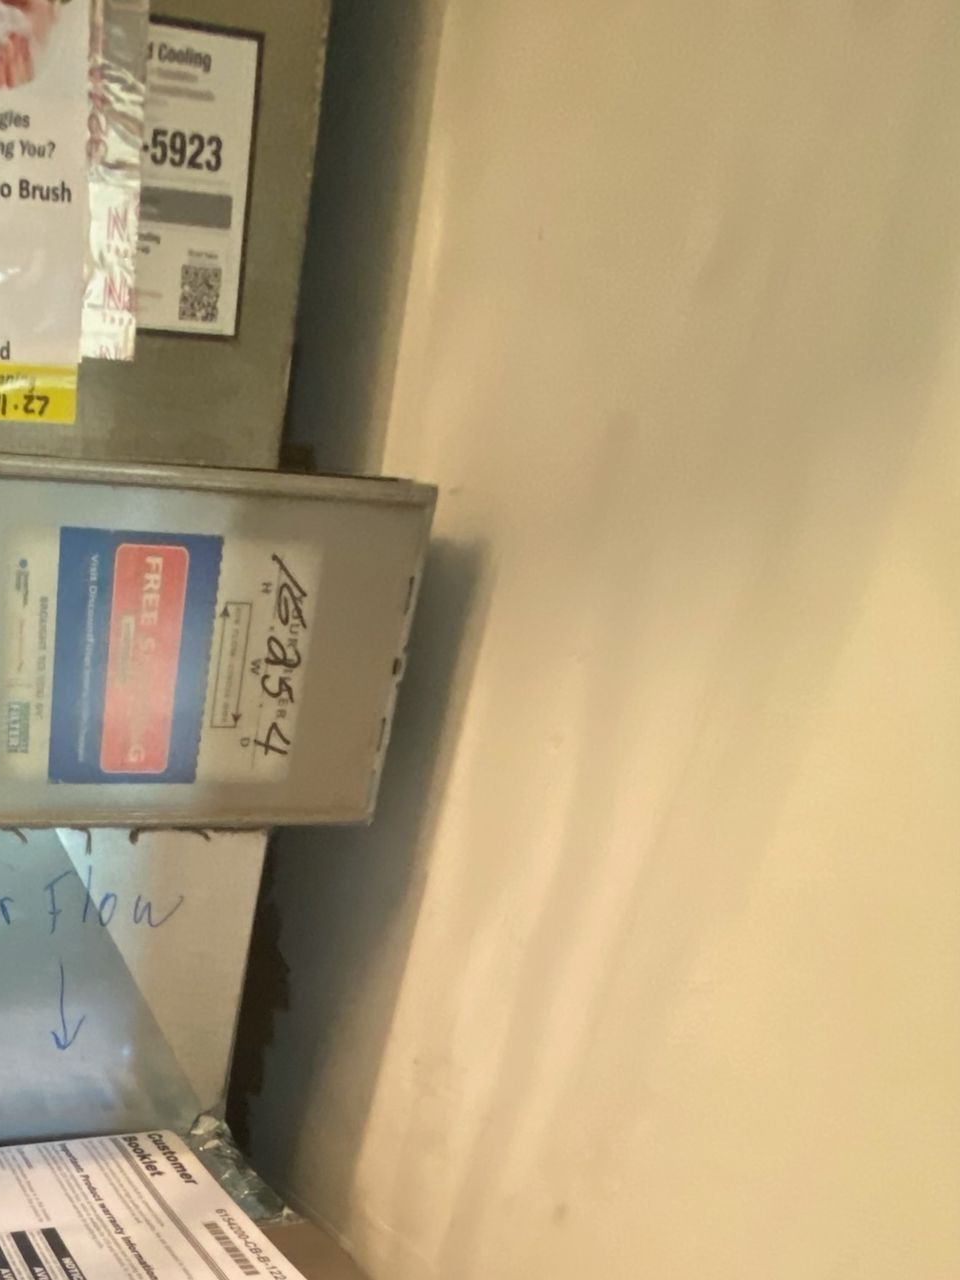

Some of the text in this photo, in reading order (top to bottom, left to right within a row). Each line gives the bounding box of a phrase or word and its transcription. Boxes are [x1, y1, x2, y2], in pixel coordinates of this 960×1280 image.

[158, 43, 212, 73] Cooling
[19, 140, 56, 160] You?
[19, 178, 73, 204] Brush
[141, 555, 163, 625] FREE
[253, 721, 291, 756] 4
[44, 863, 185, 935] Flow
[118, 1135, 168, 1177] Booklet
[142, 1132, 204, 1185] Customer
[77, 1174, 106, 1201] Product
[94, 1202, 128, 1234] warranty
[120, 1236, 162, 1280] information
